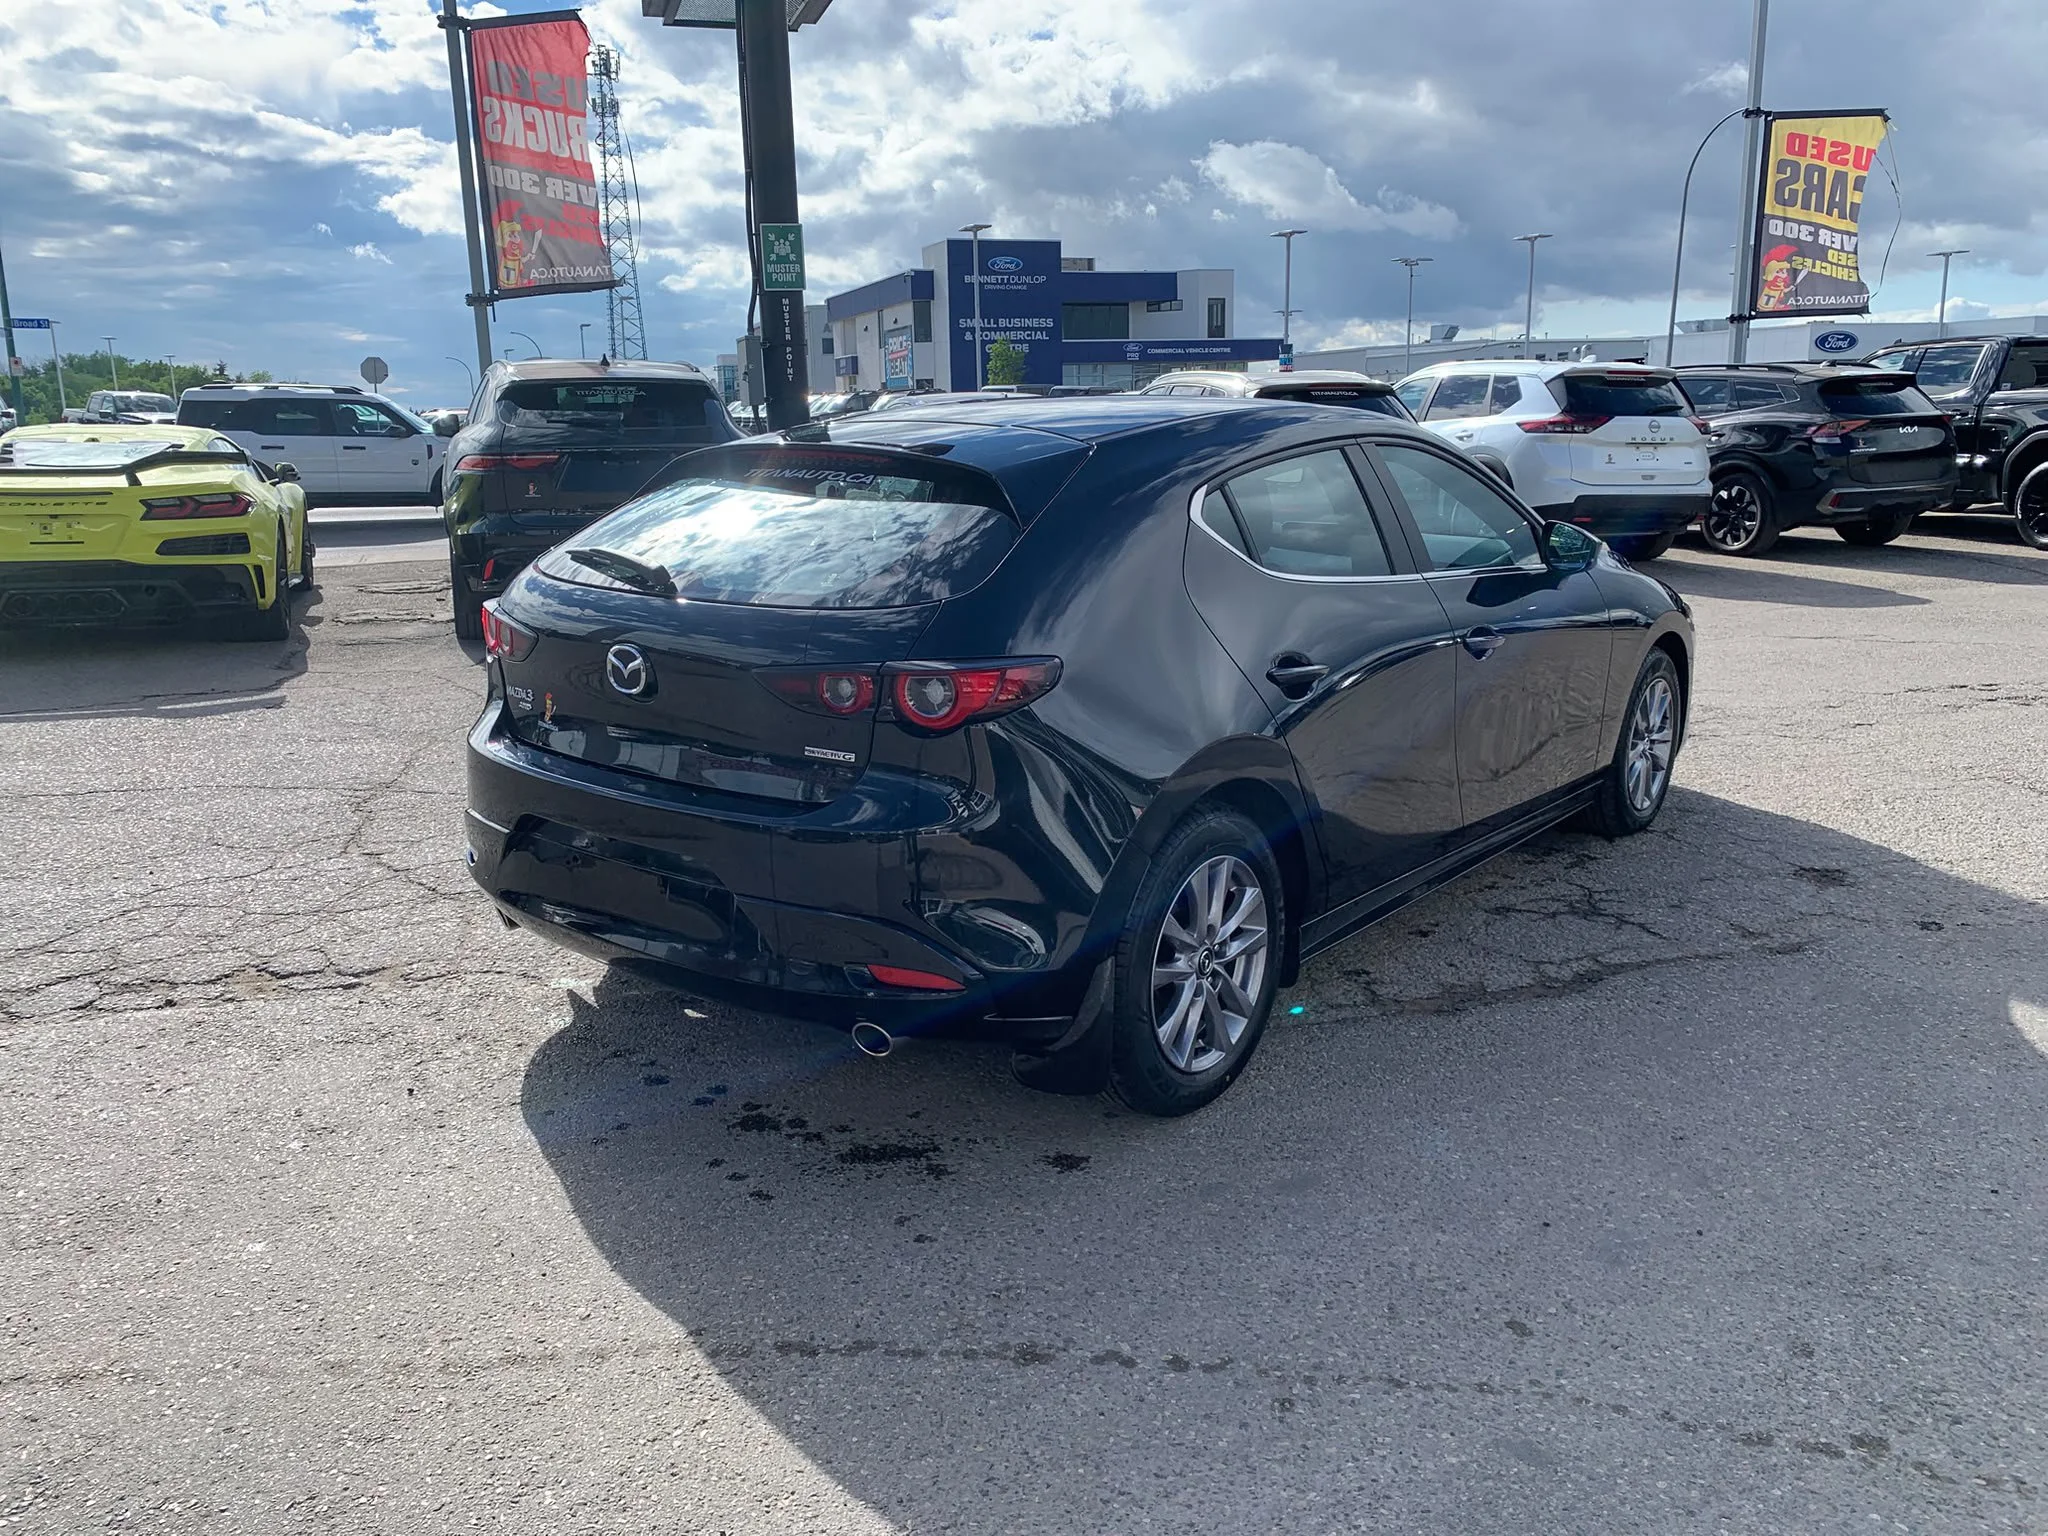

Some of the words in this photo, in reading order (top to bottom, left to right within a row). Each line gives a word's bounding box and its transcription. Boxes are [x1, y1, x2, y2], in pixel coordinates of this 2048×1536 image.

[766, 263, 801, 273] MUSTER
[772, 273, 797, 282] POINT
[1009, 275, 1047, 284] DUNLOP
[14, 319, 38, 328] Broad
[40, 319, 49, 328] St
[781, 298, 792, 341] MUSTER
[959, 318, 997, 328] SMALL
[998, 318, 1054, 328] BUSINESS
[964, 331, 973, 341] &
[985, 343, 1030, 353] CTRE
[786, 347, 794, 382] POINT
[743, 468, 876, 484] TITANAUTO.CA
